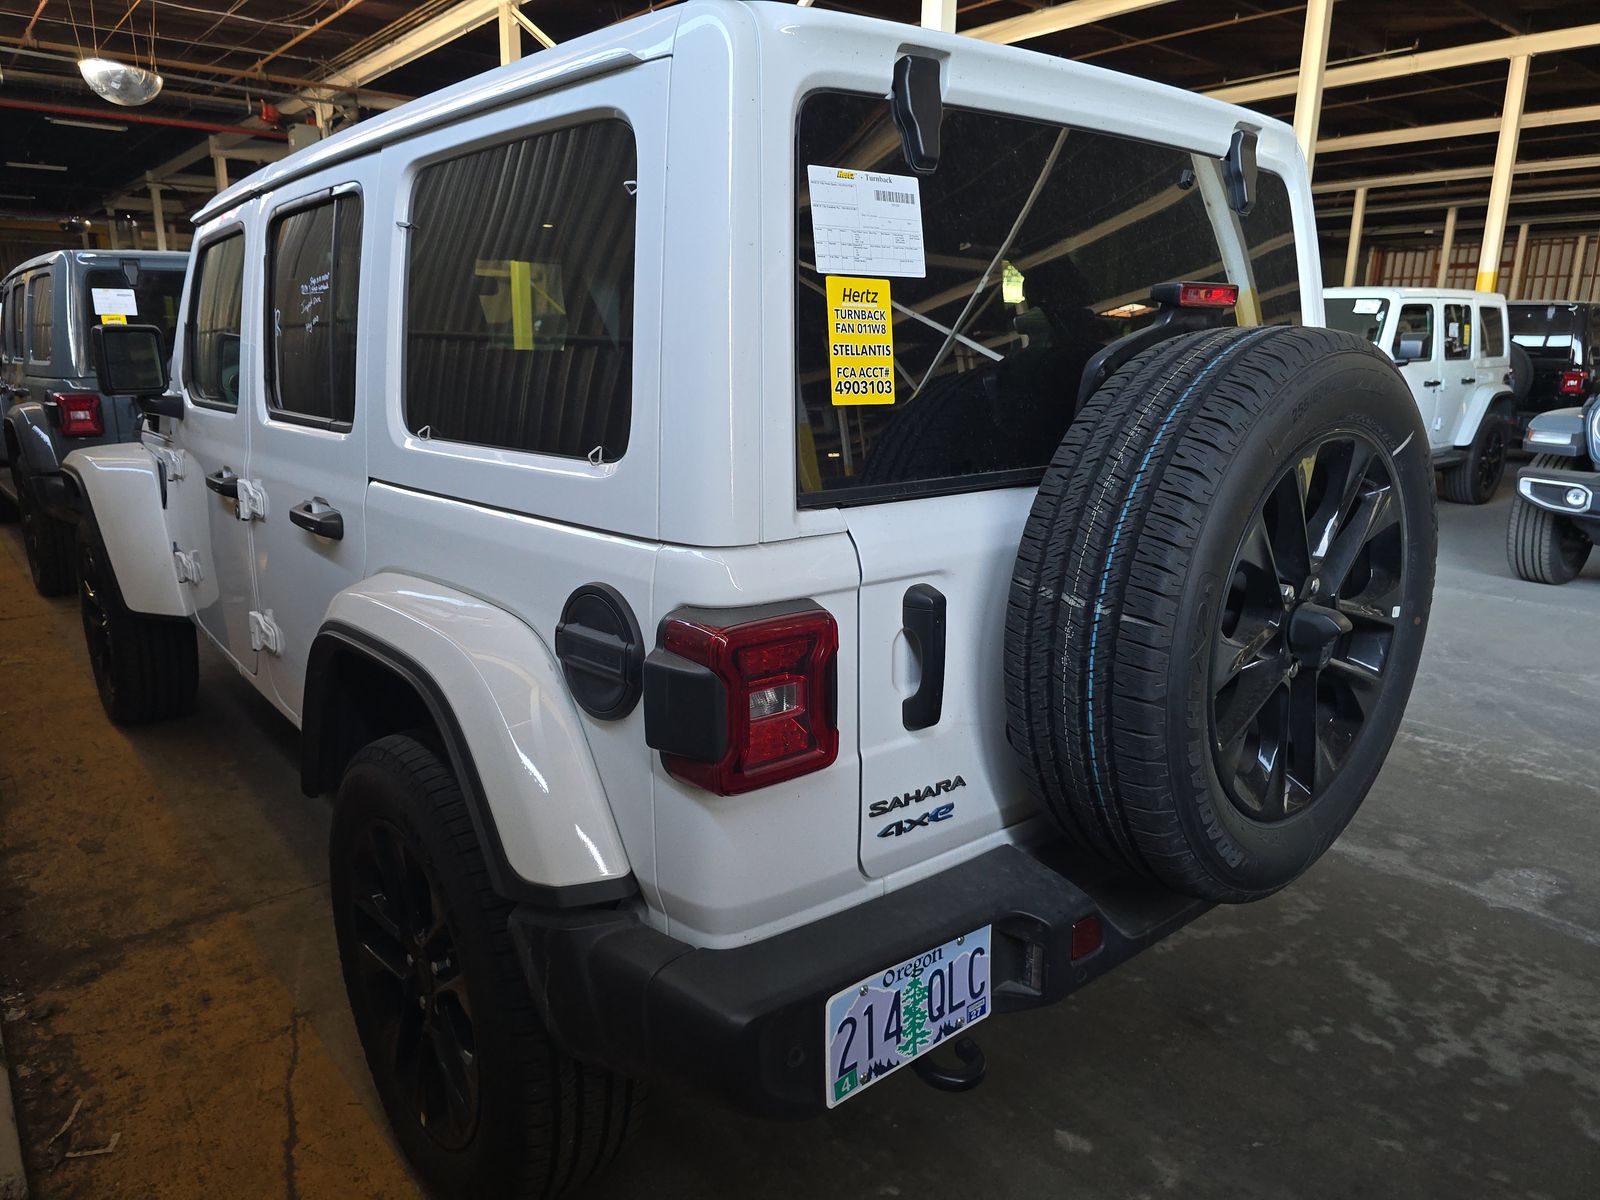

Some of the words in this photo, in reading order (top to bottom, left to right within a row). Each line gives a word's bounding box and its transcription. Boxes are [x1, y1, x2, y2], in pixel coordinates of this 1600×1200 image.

[865, 174, 893, 184] Turnback
[842, 288, 879, 303] Hertz
[834, 309, 886, 321] TURNBACK
[835, 323, 855, 334] FAN
[857, 323, 886, 334] 011W8
[833, 344, 891, 356] STELLANTIS
[837, 367, 856, 378] FCA
[859, 367, 890, 378] ACCT#
[835, 380, 892, 395] 4903103
[868, 775, 967, 818] SAHARA
[1187, 738, 1246, 869] ROADIAN
[882, 947, 943, 988] Oregon
[837, 989, 903, 1079] 214
[928, 947, 985, 1023] QLC
[971, 1007, 981, 1020] 27
[841, 1077, 851, 1093] 4
